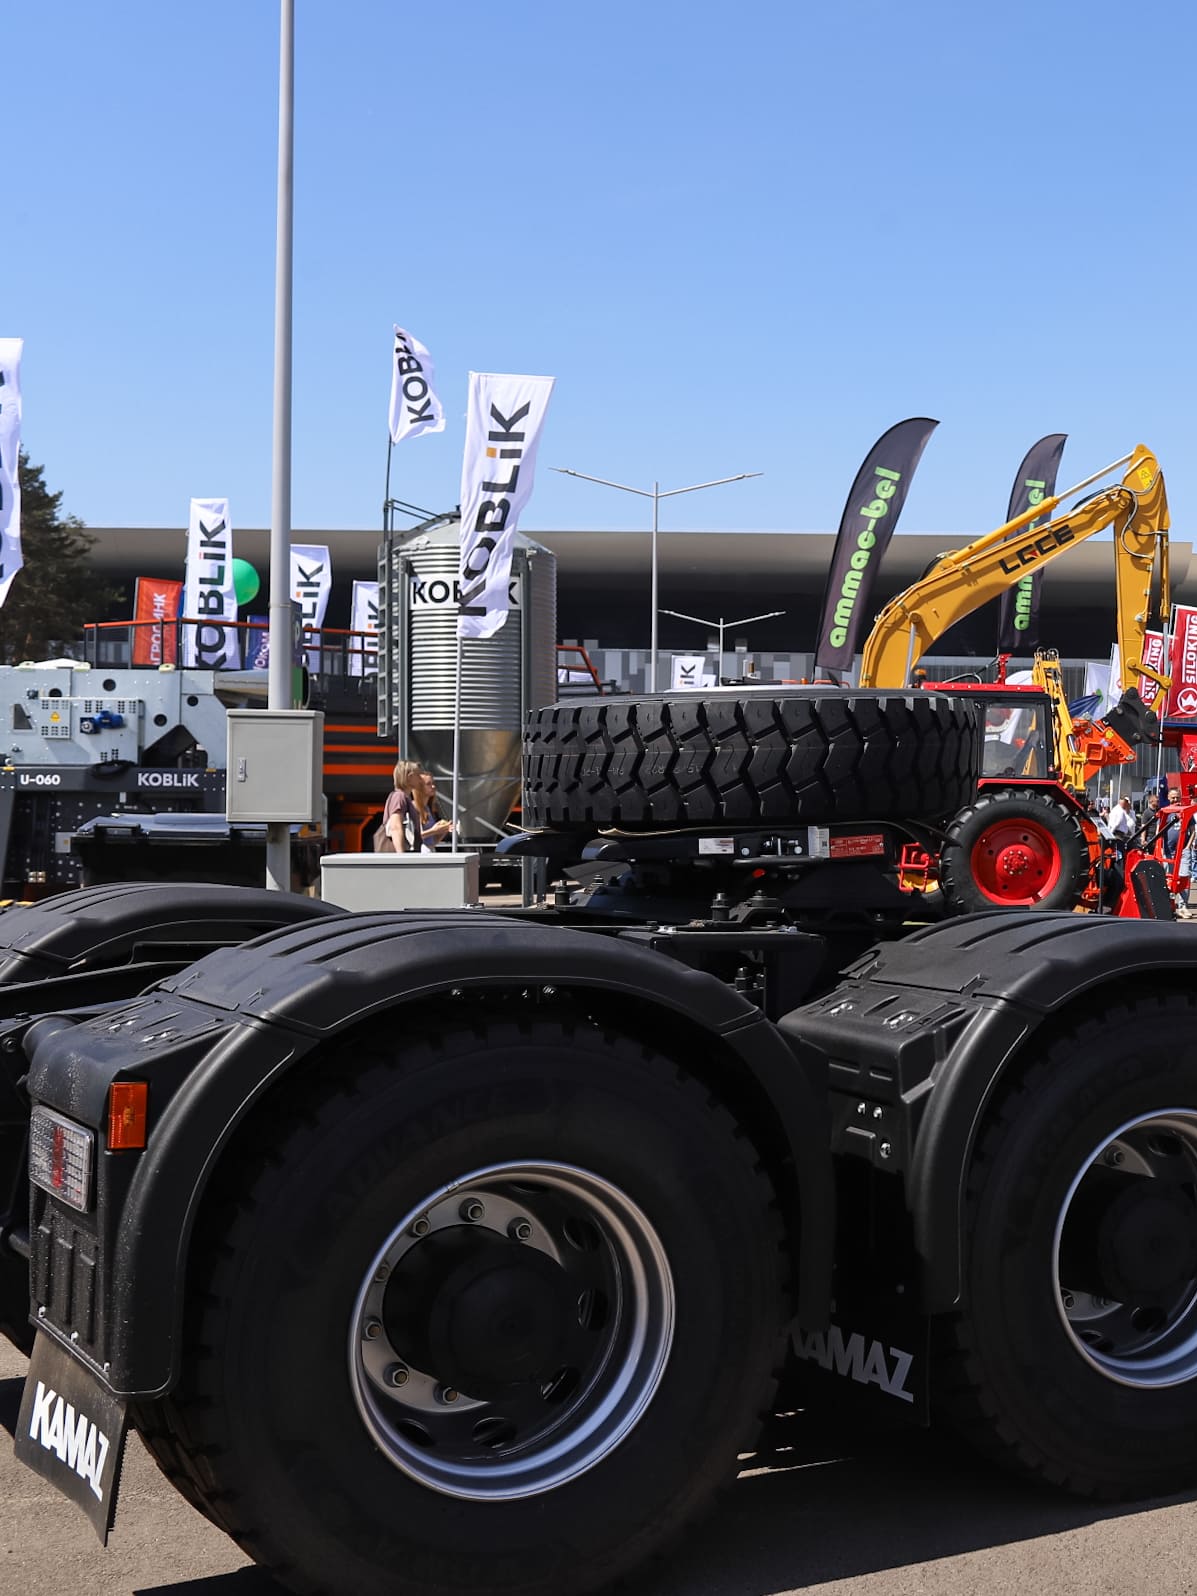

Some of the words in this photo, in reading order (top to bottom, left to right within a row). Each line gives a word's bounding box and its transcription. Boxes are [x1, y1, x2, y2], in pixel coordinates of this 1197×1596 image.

[829, 466, 901, 648] ammac-bel
[998, 524, 1075, 575] LGCE
[413, 580, 519, 605] KOBK
[1144, 639, 1162, 700] SILKING
[20, 775, 61, 785] U-060
[29, 1381, 110, 1502] KAMAZ
